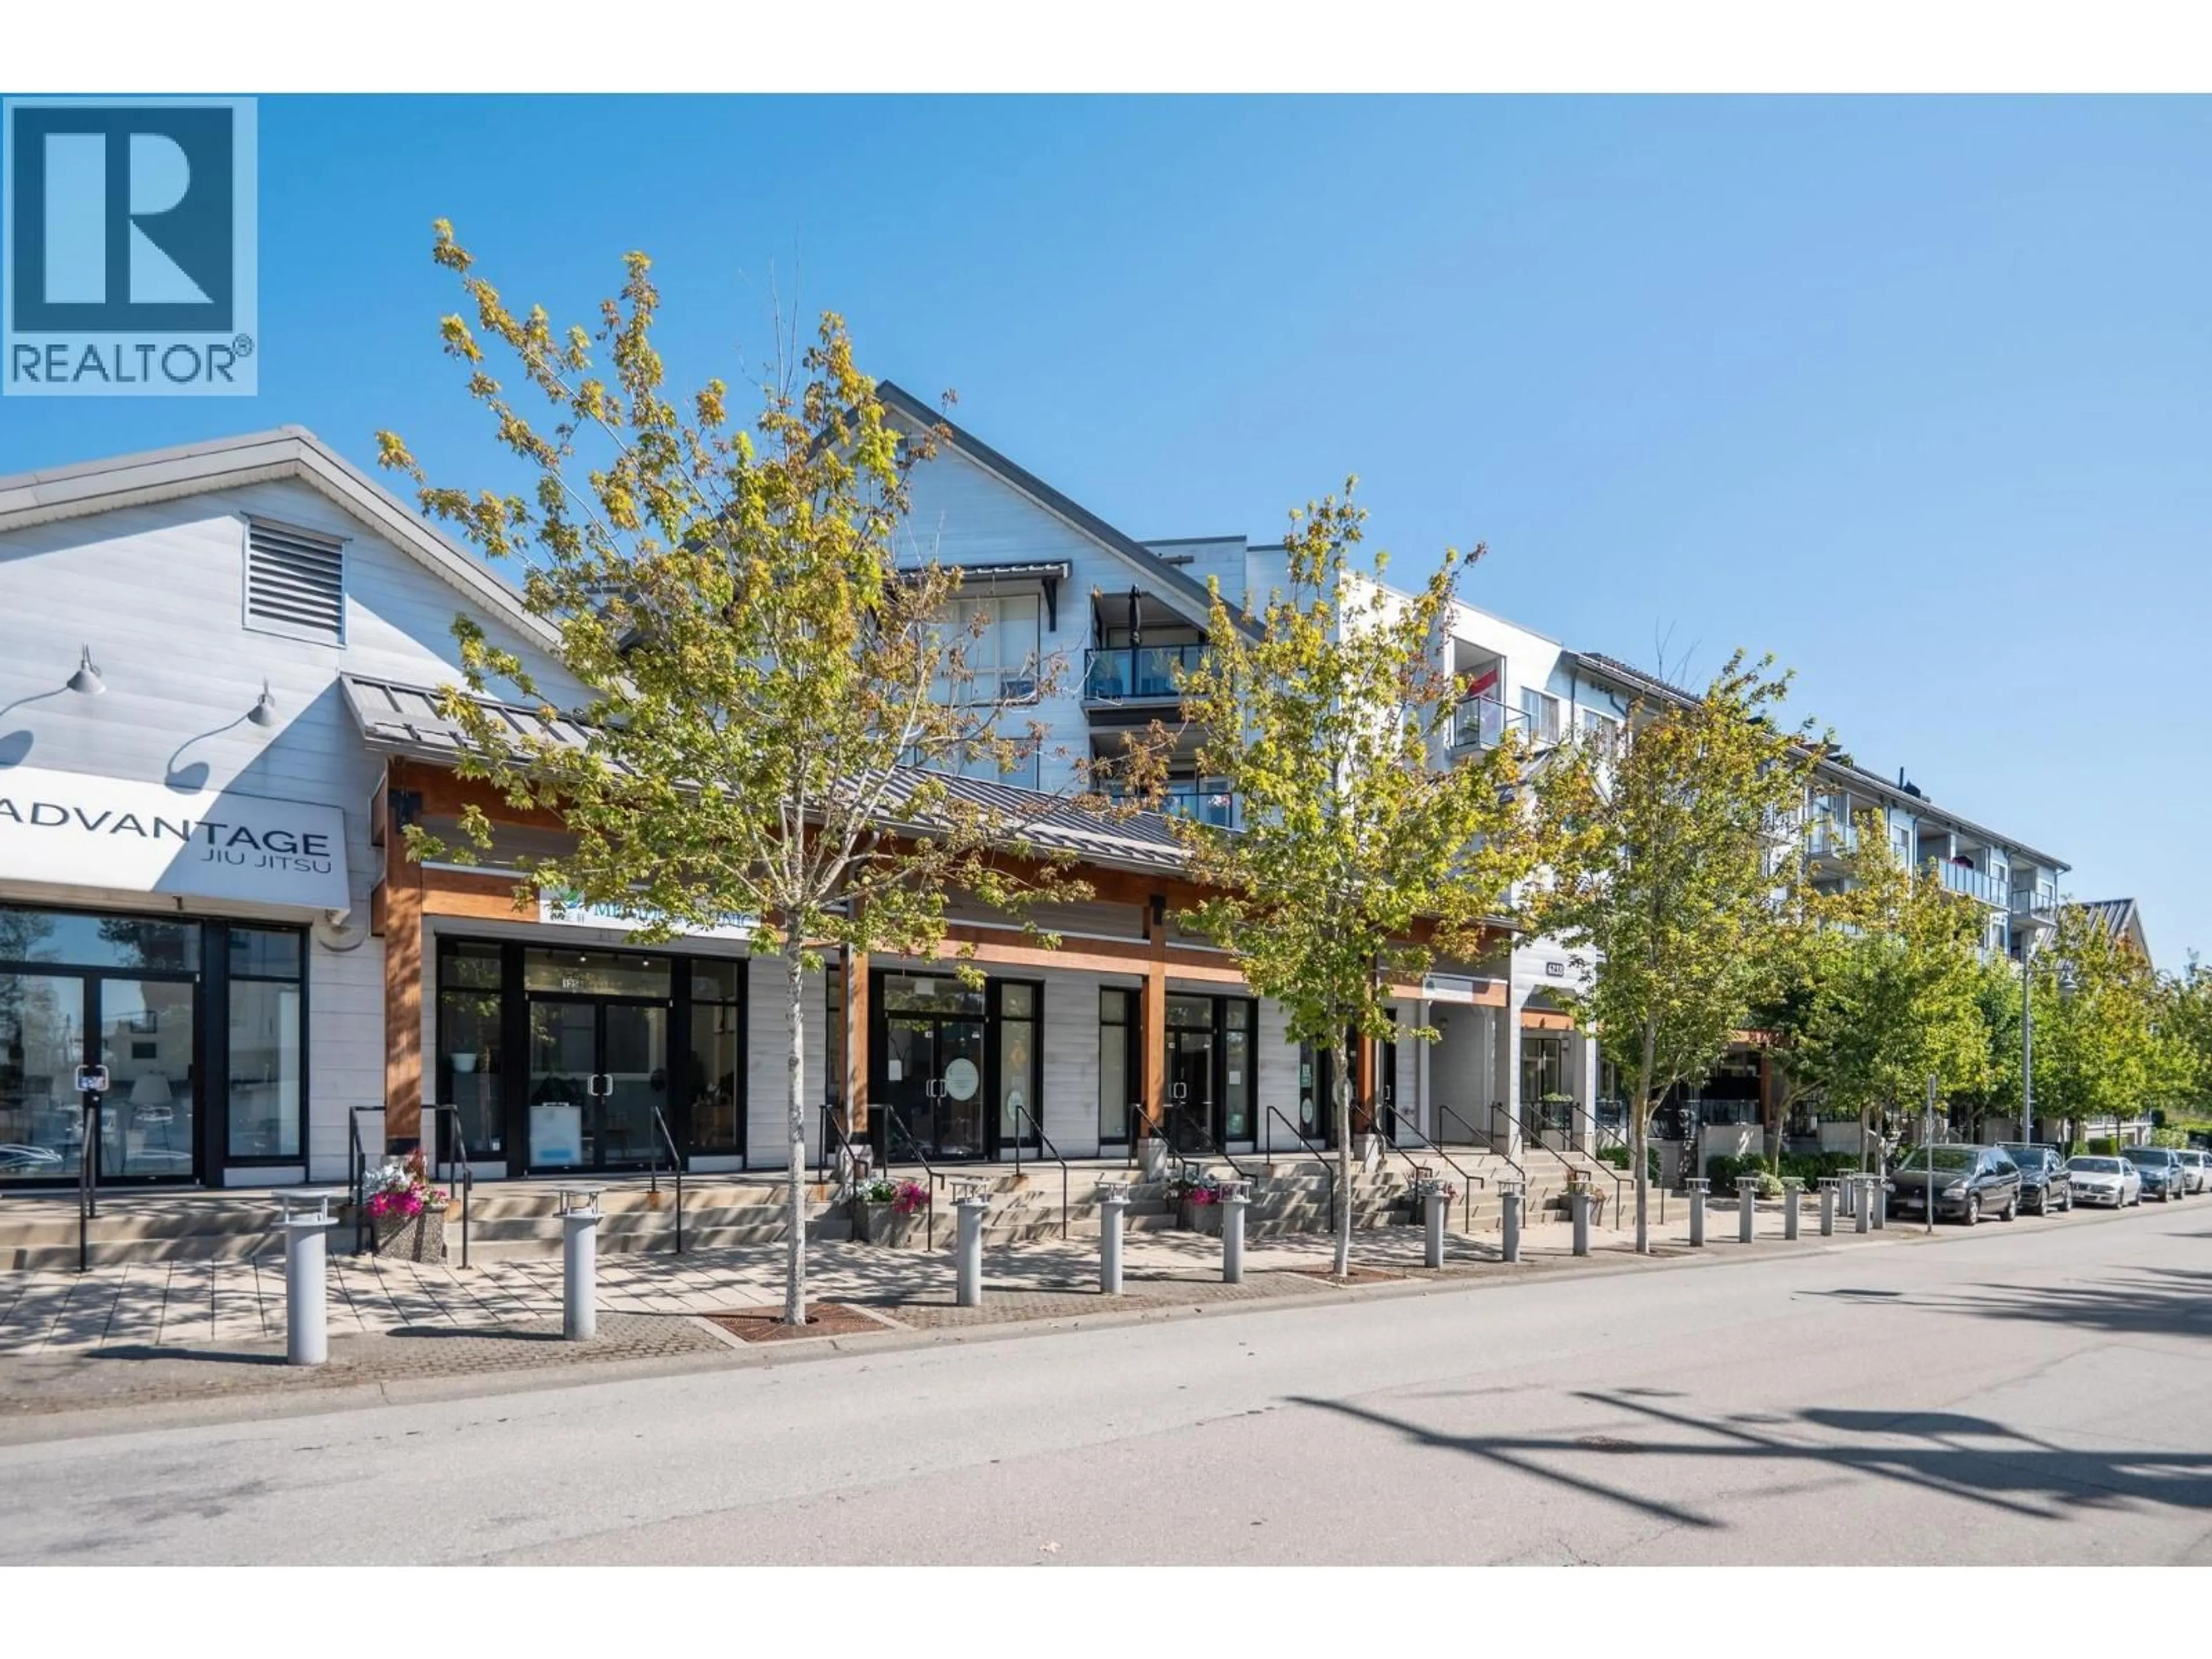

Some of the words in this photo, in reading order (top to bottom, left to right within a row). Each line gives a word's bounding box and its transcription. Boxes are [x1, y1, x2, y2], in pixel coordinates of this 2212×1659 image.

[0, 798, 331, 857] ADVANTAGE
[199, 848, 245, 865] JIU
[255, 854, 332, 874] JITSU
